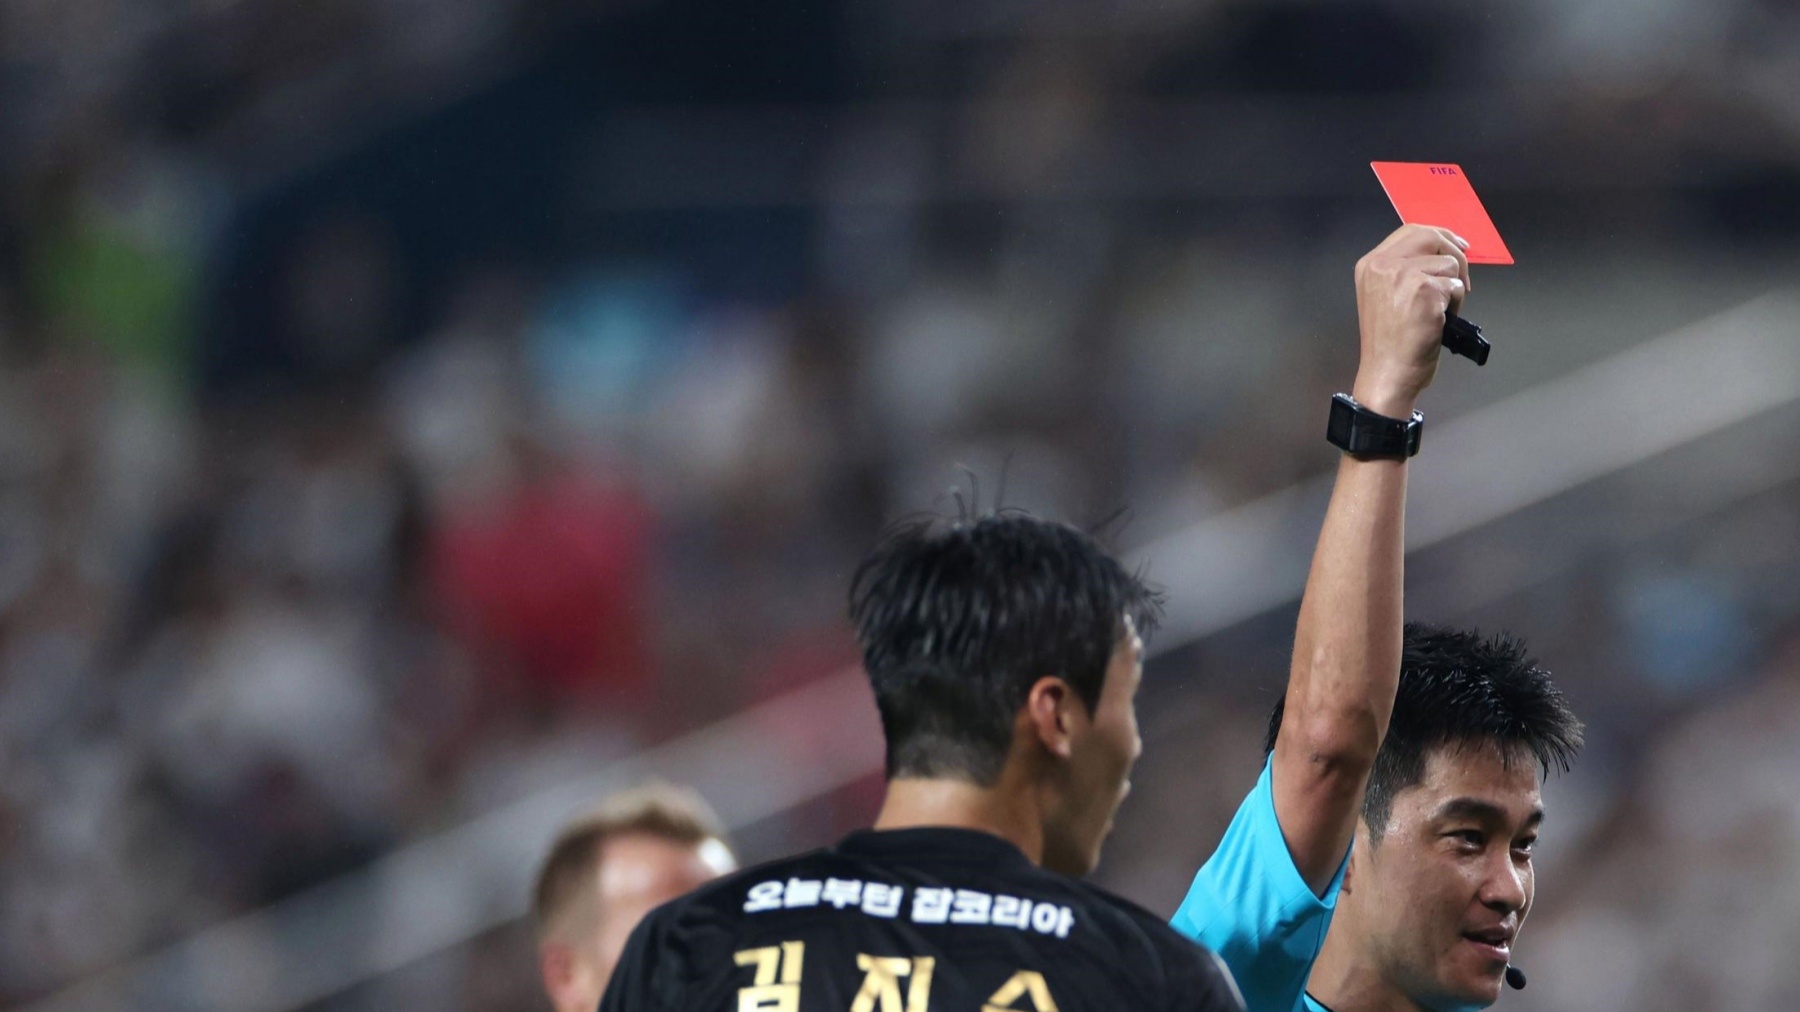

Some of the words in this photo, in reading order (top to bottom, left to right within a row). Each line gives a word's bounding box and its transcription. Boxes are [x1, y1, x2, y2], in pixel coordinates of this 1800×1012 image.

[1430, 167, 1457, 175] FIFA
[744, 878, 903, 917] 오늘부턴
[912, 887, 1075, 938] 잡코리아
